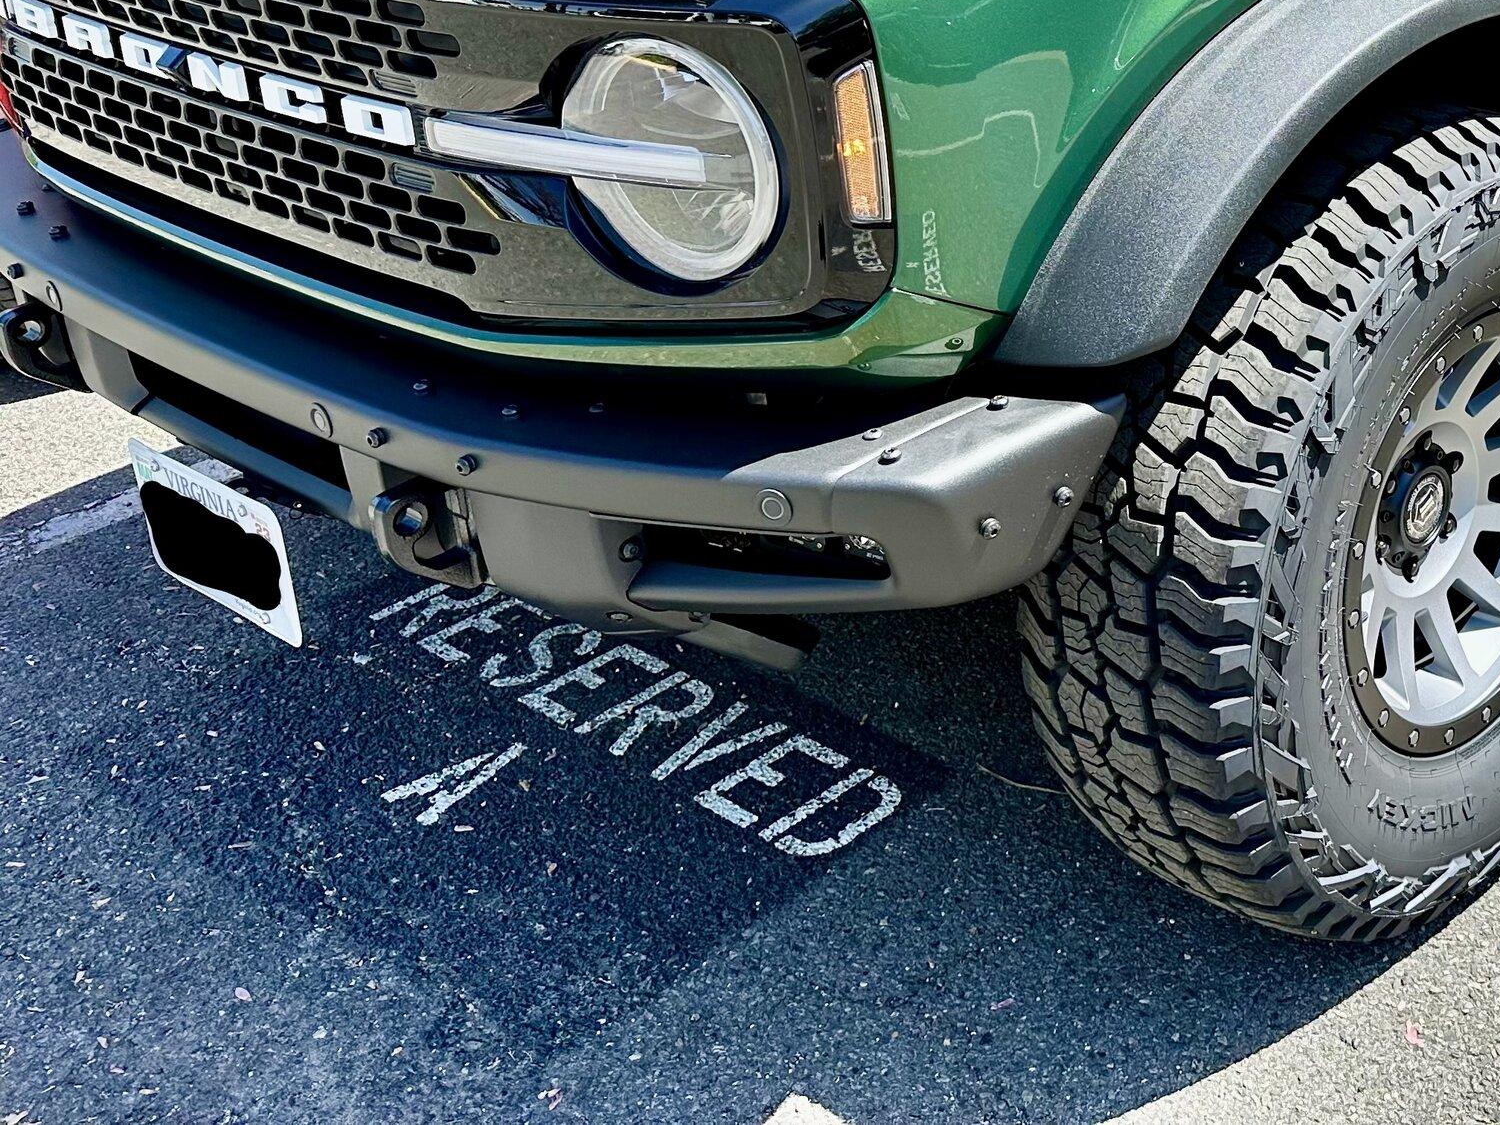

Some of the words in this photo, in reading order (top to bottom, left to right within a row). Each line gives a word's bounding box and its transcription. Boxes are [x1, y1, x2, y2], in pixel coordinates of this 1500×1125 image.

[163, 466, 240, 523] VIRGINIA
[254, 522, 271, 543] 23
[369, 583, 901, 856] RESERVED
